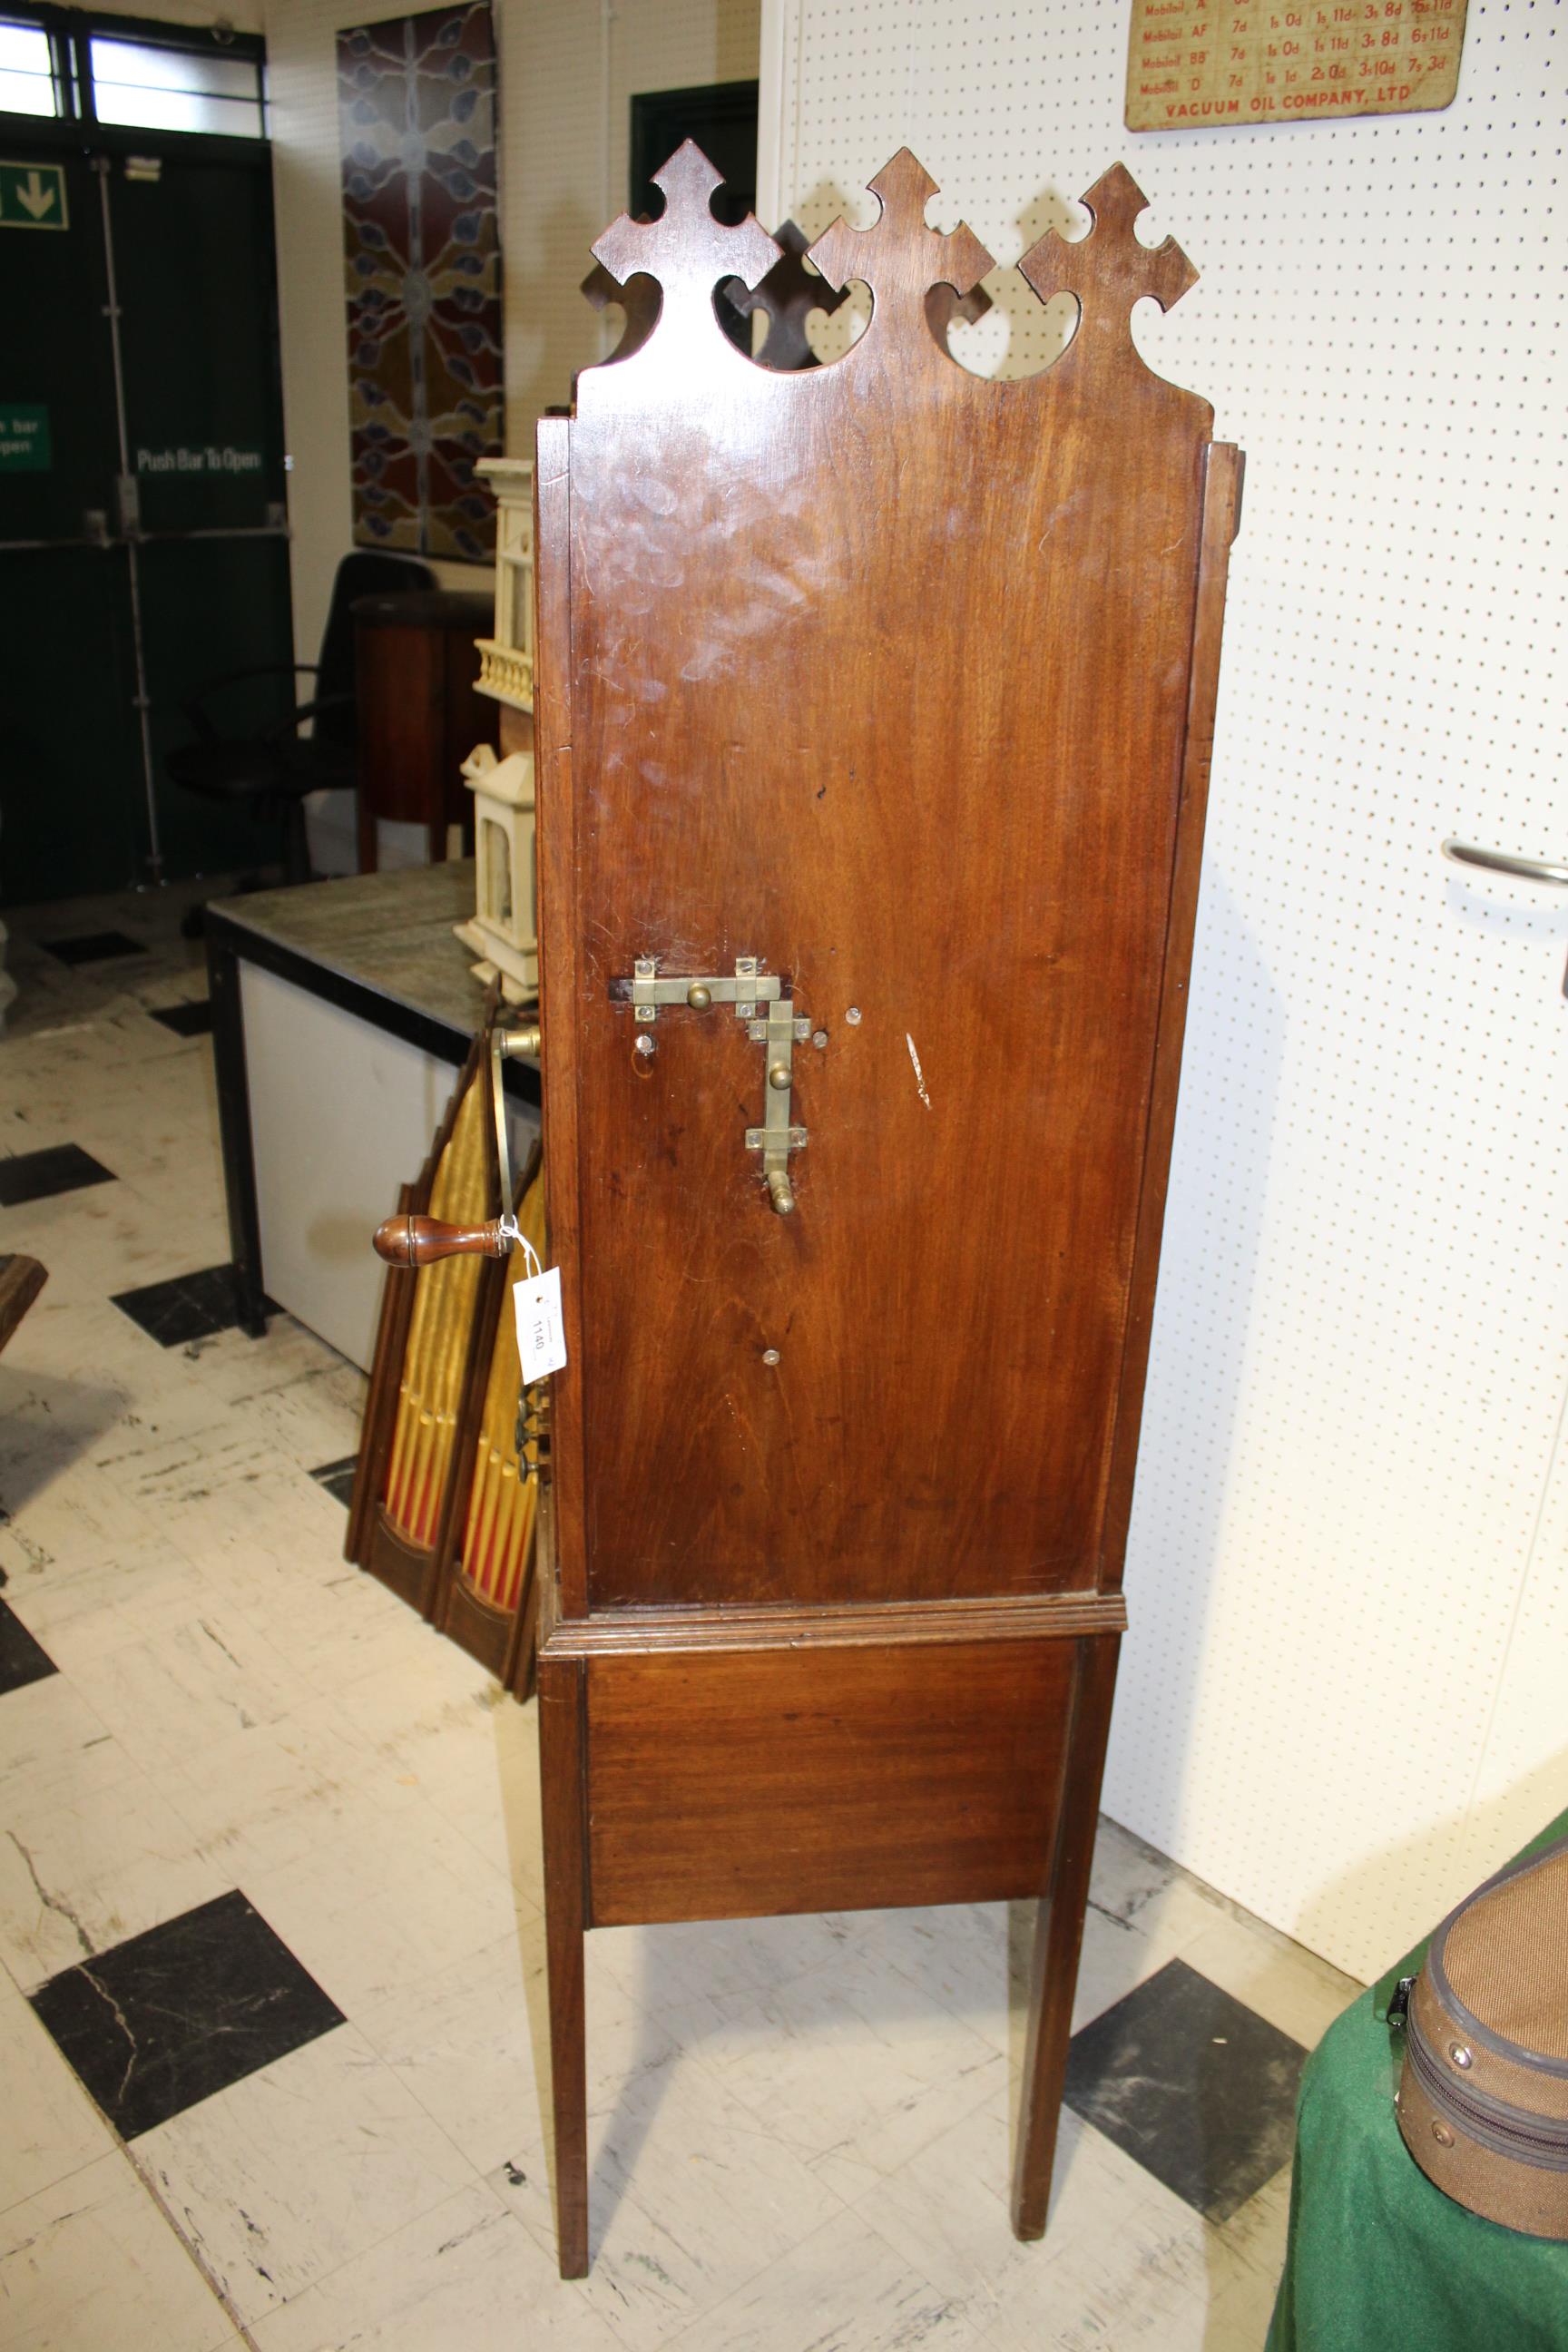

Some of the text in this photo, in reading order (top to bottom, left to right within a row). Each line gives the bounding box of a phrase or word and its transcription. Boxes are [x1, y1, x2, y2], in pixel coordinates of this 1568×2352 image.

[1143, 28, 1182, 43] Mobiloil
[1232, 20, 1247, 33] 7d
[1333, 8, 1351, 22] 11d
[1364, 5, 1378, 19] 3s
[1385, 2, 1402, 16] 8d
[1142, 54, 1181, 69] Mobiloil
[1230, 47, 1245, 60] 7d
[1331, 38, 1348, 51] 11d
[1362, 34, 1375, 48] 3s
[1381, 31, 1398, 46] 8d
[1229, 74, 1243, 87] 7d
[1311, 67, 1324, 80] 2s
[1408, 57, 1422, 73] 7s
[1428, 55, 1446, 71] 3d
[1166, 85, 1411, 117] VACUUM OIL COMPANY, LTD
[137, 446, 261, 474] Push Bar To Open
[533, 1320, 544, 1350] 1140
